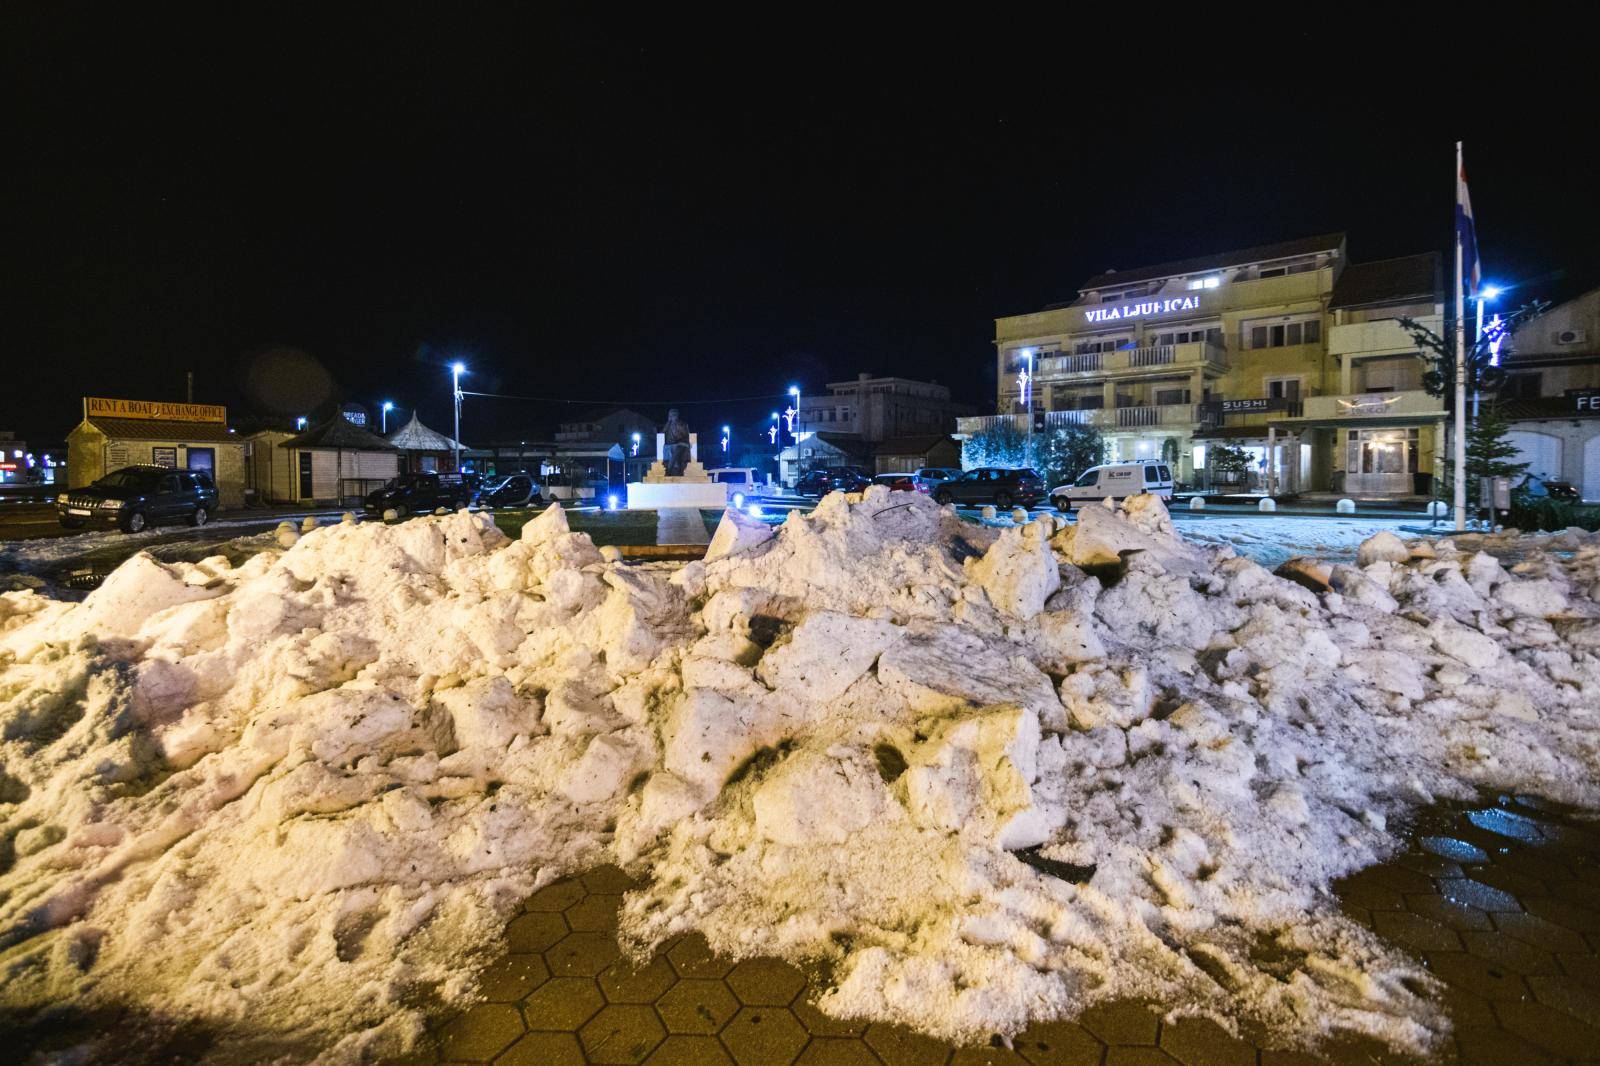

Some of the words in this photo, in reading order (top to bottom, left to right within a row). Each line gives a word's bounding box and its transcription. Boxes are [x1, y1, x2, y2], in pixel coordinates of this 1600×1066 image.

[1085, 308, 1120, 322] VILA
[91, 399, 117, 412] RENT
[119, 401, 126, 413] A
[128, 402, 152, 414] BOAT
[162, 404, 198, 417] EXCHANGE
[199, 406, 223, 418] OFFICE
[1223, 400, 1267, 409] SUSHI
